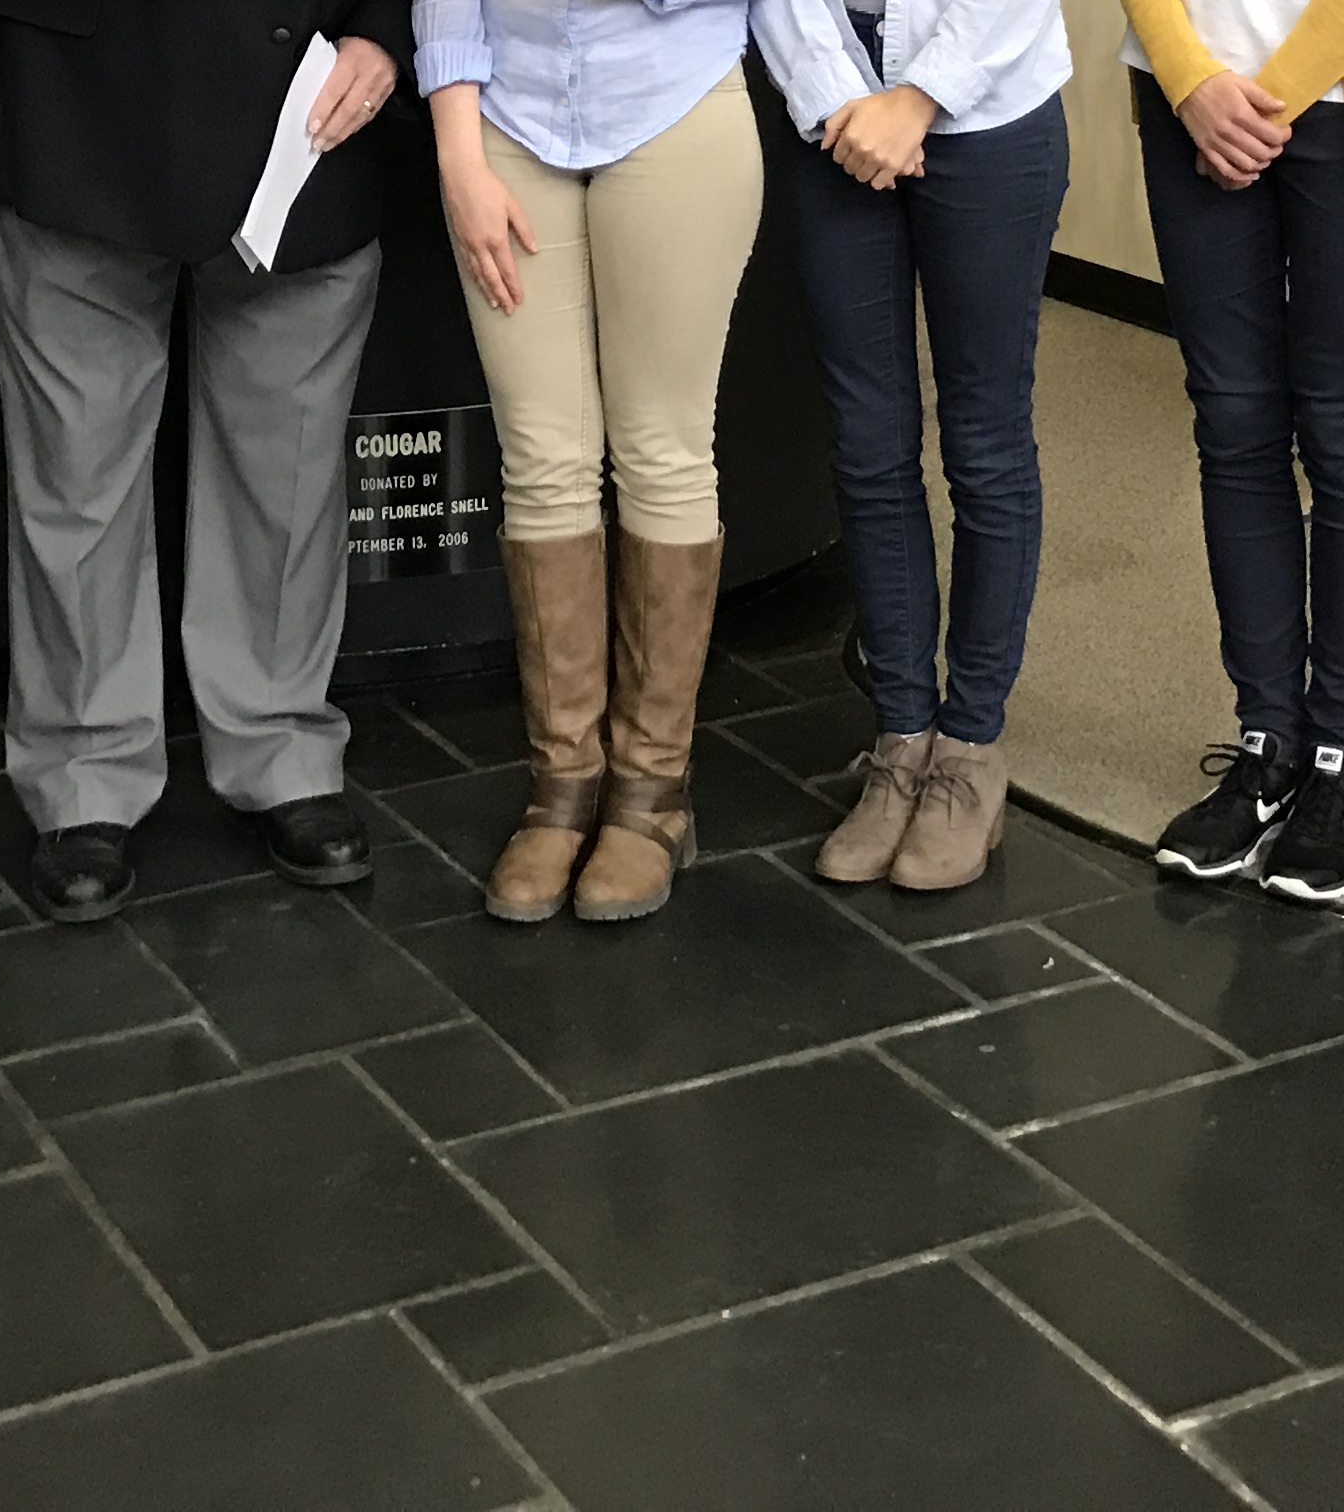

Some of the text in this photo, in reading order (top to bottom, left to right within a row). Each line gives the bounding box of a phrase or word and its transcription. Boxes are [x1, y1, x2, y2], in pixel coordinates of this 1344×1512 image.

[355, 430, 442, 458] COUGAR
[360, 472, 438, 491] DONATED BY
[349, 497, 489, 522] AND FLORENCE SNELL
[348, 531, 469, 554] PTEMBER 13, 2006
